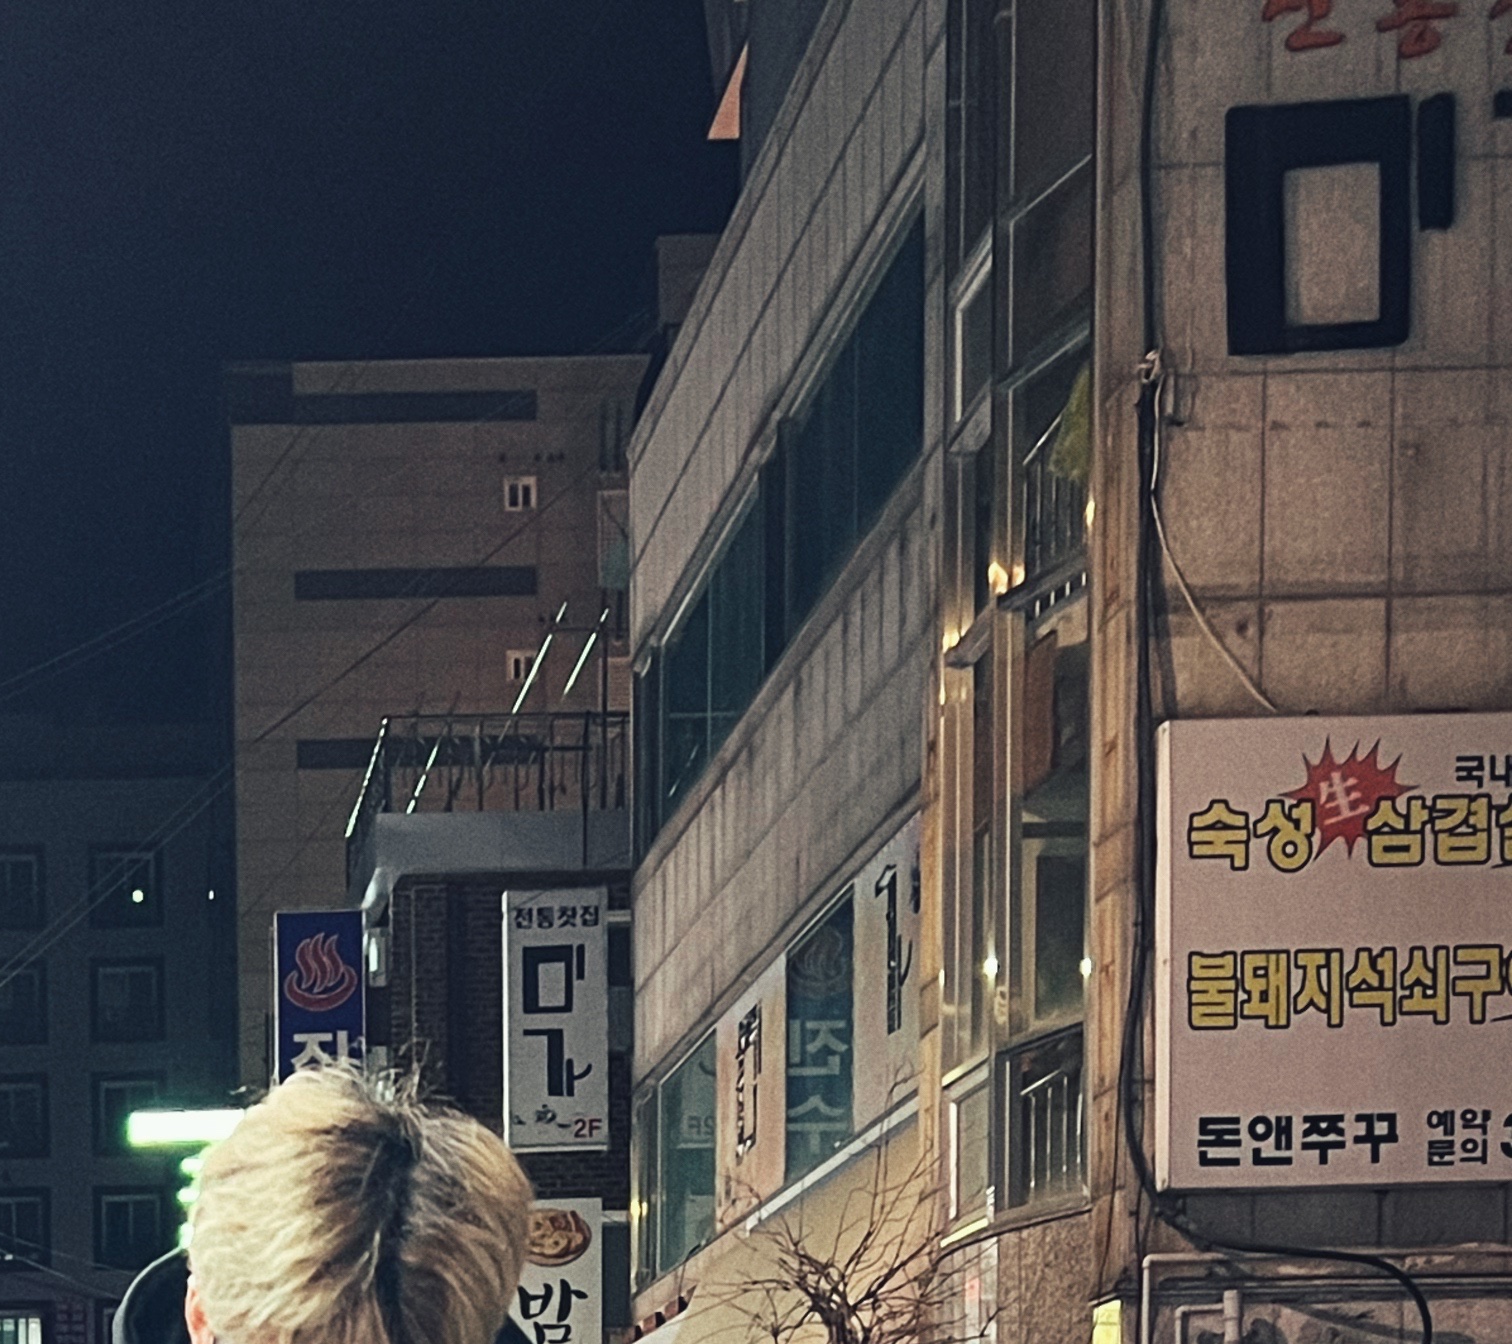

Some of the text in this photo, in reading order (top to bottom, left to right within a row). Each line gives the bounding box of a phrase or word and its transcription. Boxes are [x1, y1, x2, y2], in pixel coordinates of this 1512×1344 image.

[1188, 799, 1317, 873] 숙성
[1365, 793, 1512, 868] 삼겹
[1188, 943, 1512, 1030] 불돼지석쇠구
[574, 1118, 603, 1138] 2F
[1197, 1112, 1399, 1167] 돈앤쭈꾸
[1427, 1108, 1491, 1136] 예약
[1427, 1138, 1487, 1166] 문의
